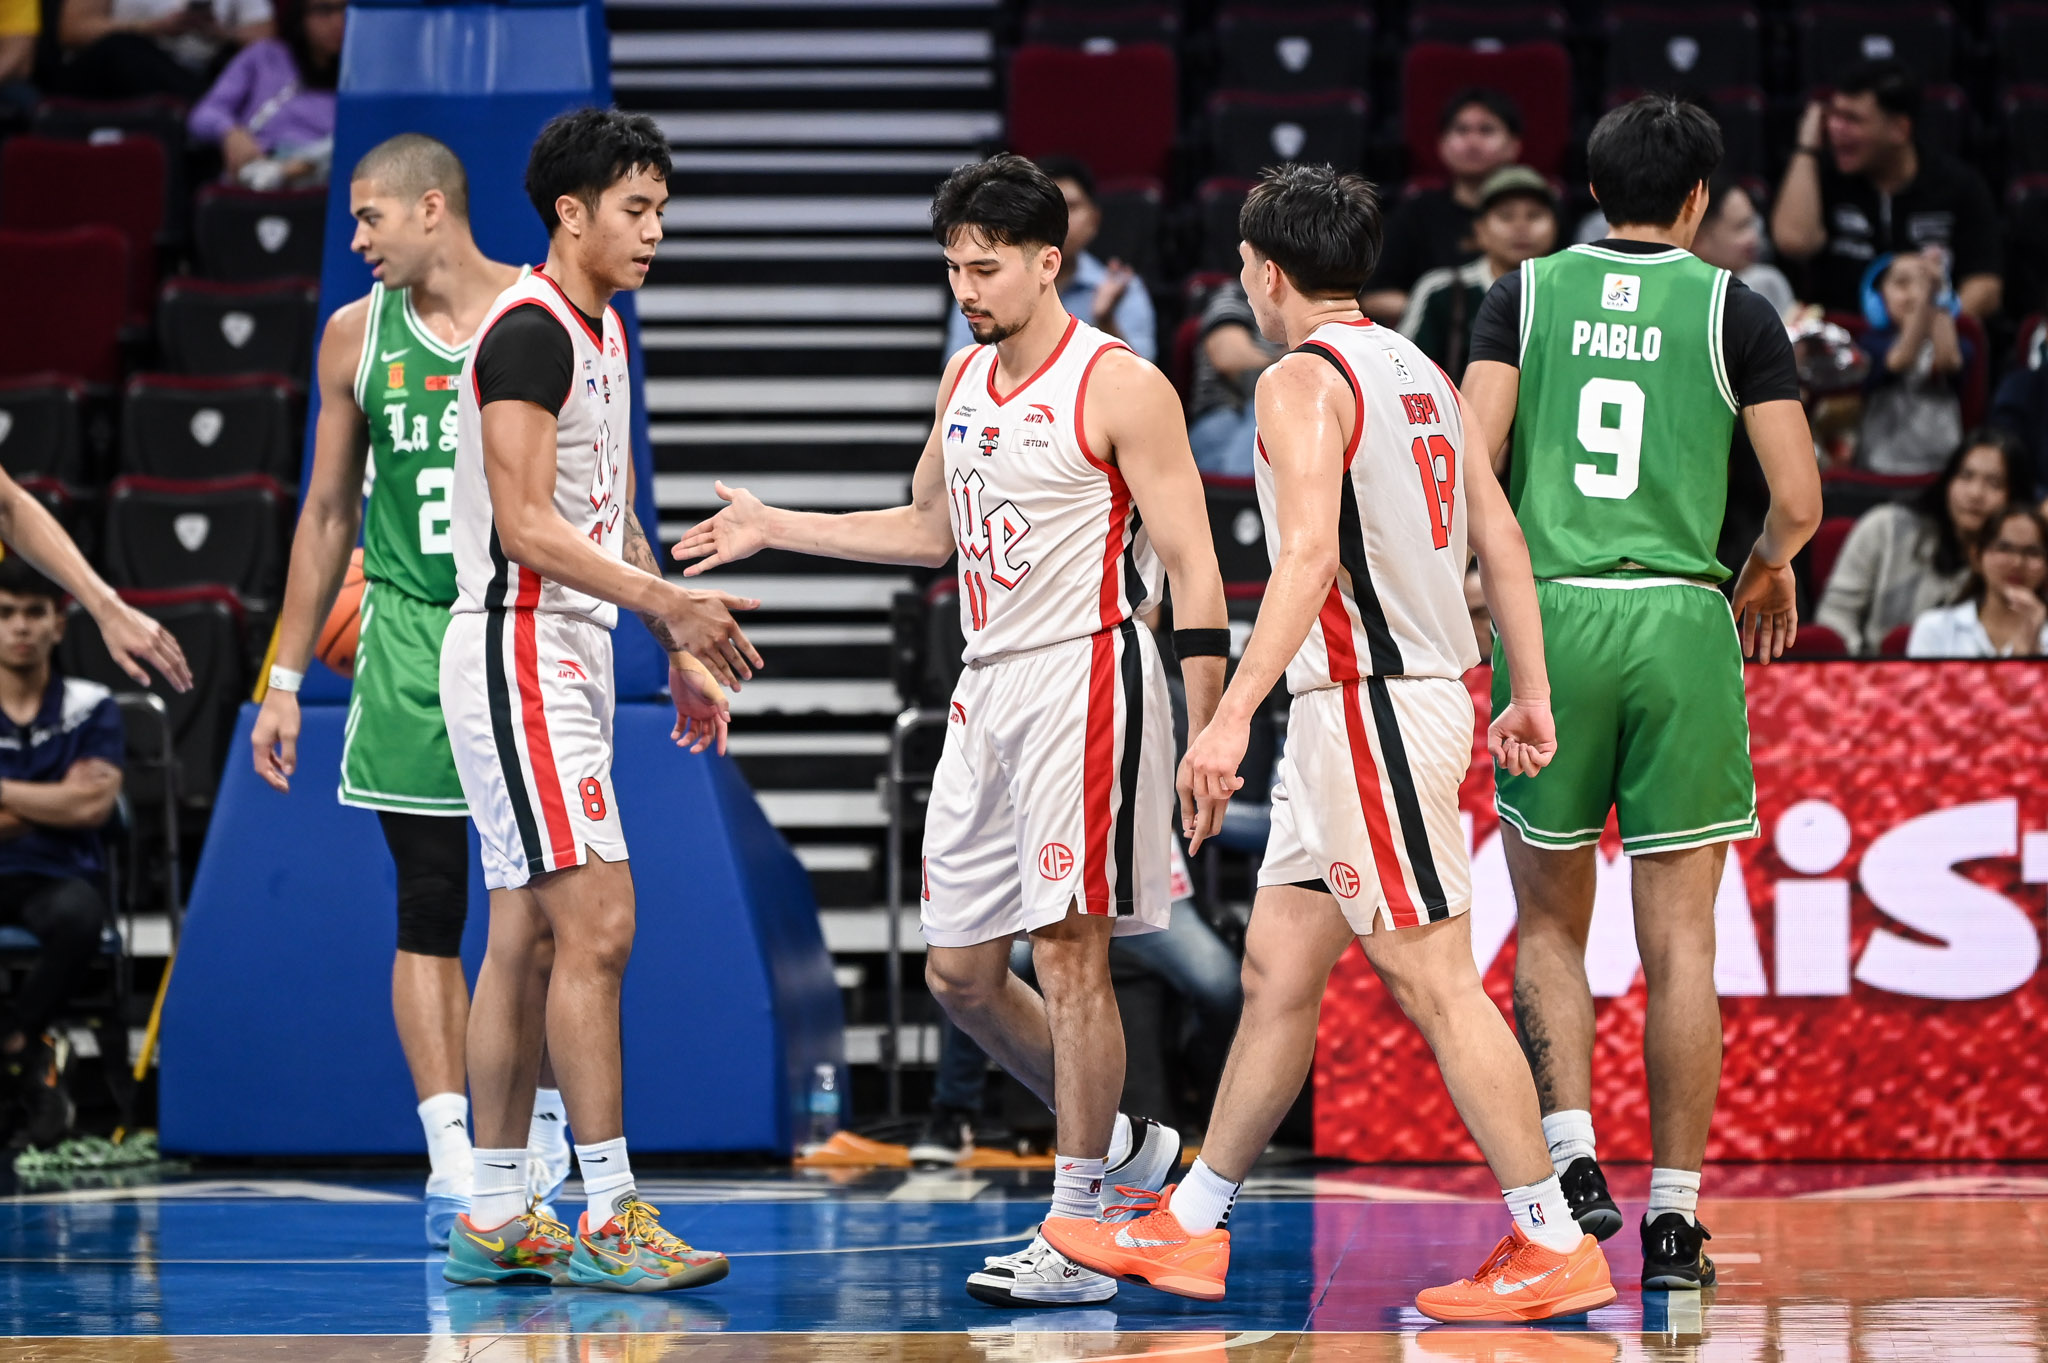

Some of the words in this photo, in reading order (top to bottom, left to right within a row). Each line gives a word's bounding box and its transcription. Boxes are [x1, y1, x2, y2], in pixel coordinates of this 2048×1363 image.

[1571, 320, 1662, 362] PABLO
[384, 402, 429, 453] La
[1023, 413, 1044, 424] ANTA
[1574, 377, 1646, 500] 9
[1023, 439, 1049, 448] ETON
[965, 570, 987, 631] 11
[557, 670, 576, 680] ANTA
[578, 777, 607, 821] 8
